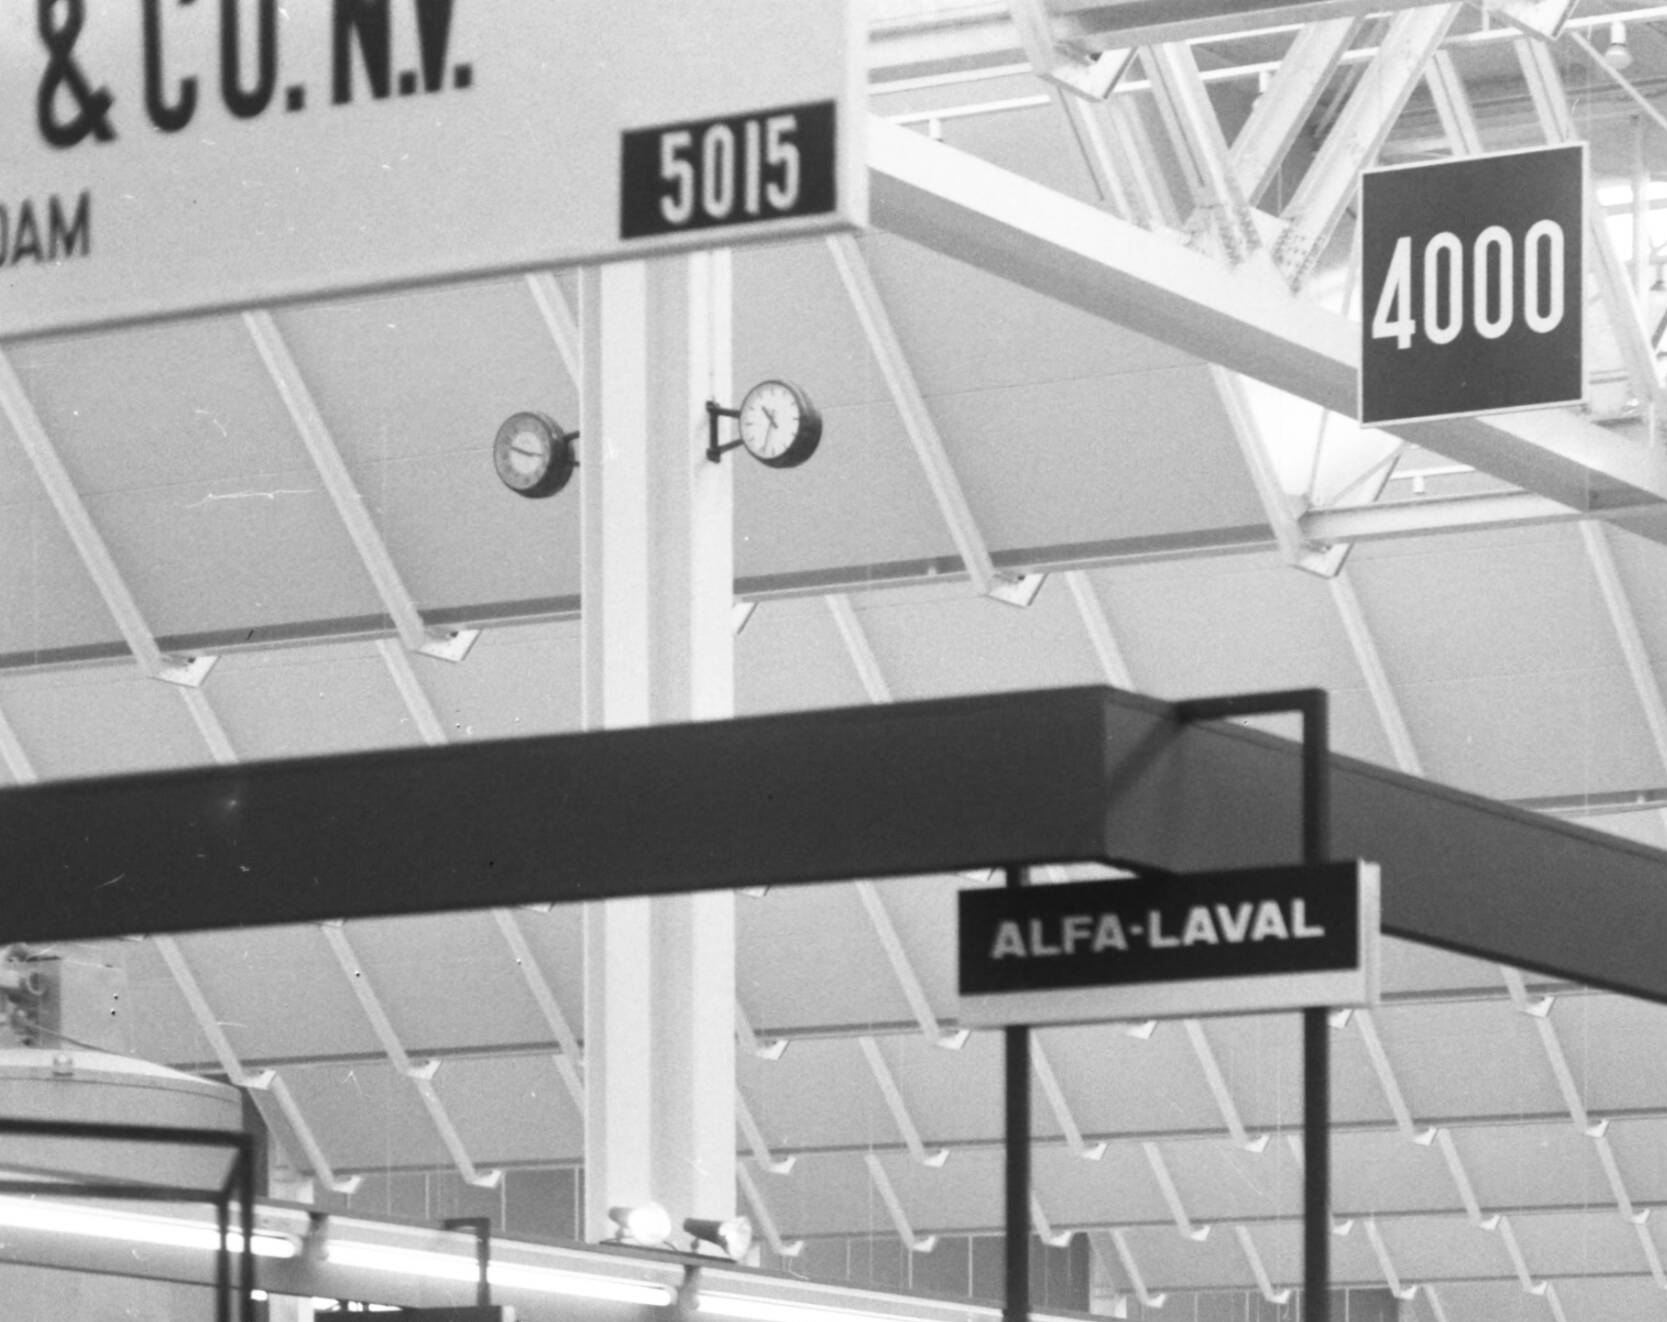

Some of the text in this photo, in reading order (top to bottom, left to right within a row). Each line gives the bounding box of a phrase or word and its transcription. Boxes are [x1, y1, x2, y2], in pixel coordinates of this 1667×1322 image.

[36, 0, 476, 150] & CO. N.V.
[659, 114, 801, 224] 5015
[1372, 219, 1565, 351] 4000
[991, 897, 1325, 959] ALFA-LAVAL
